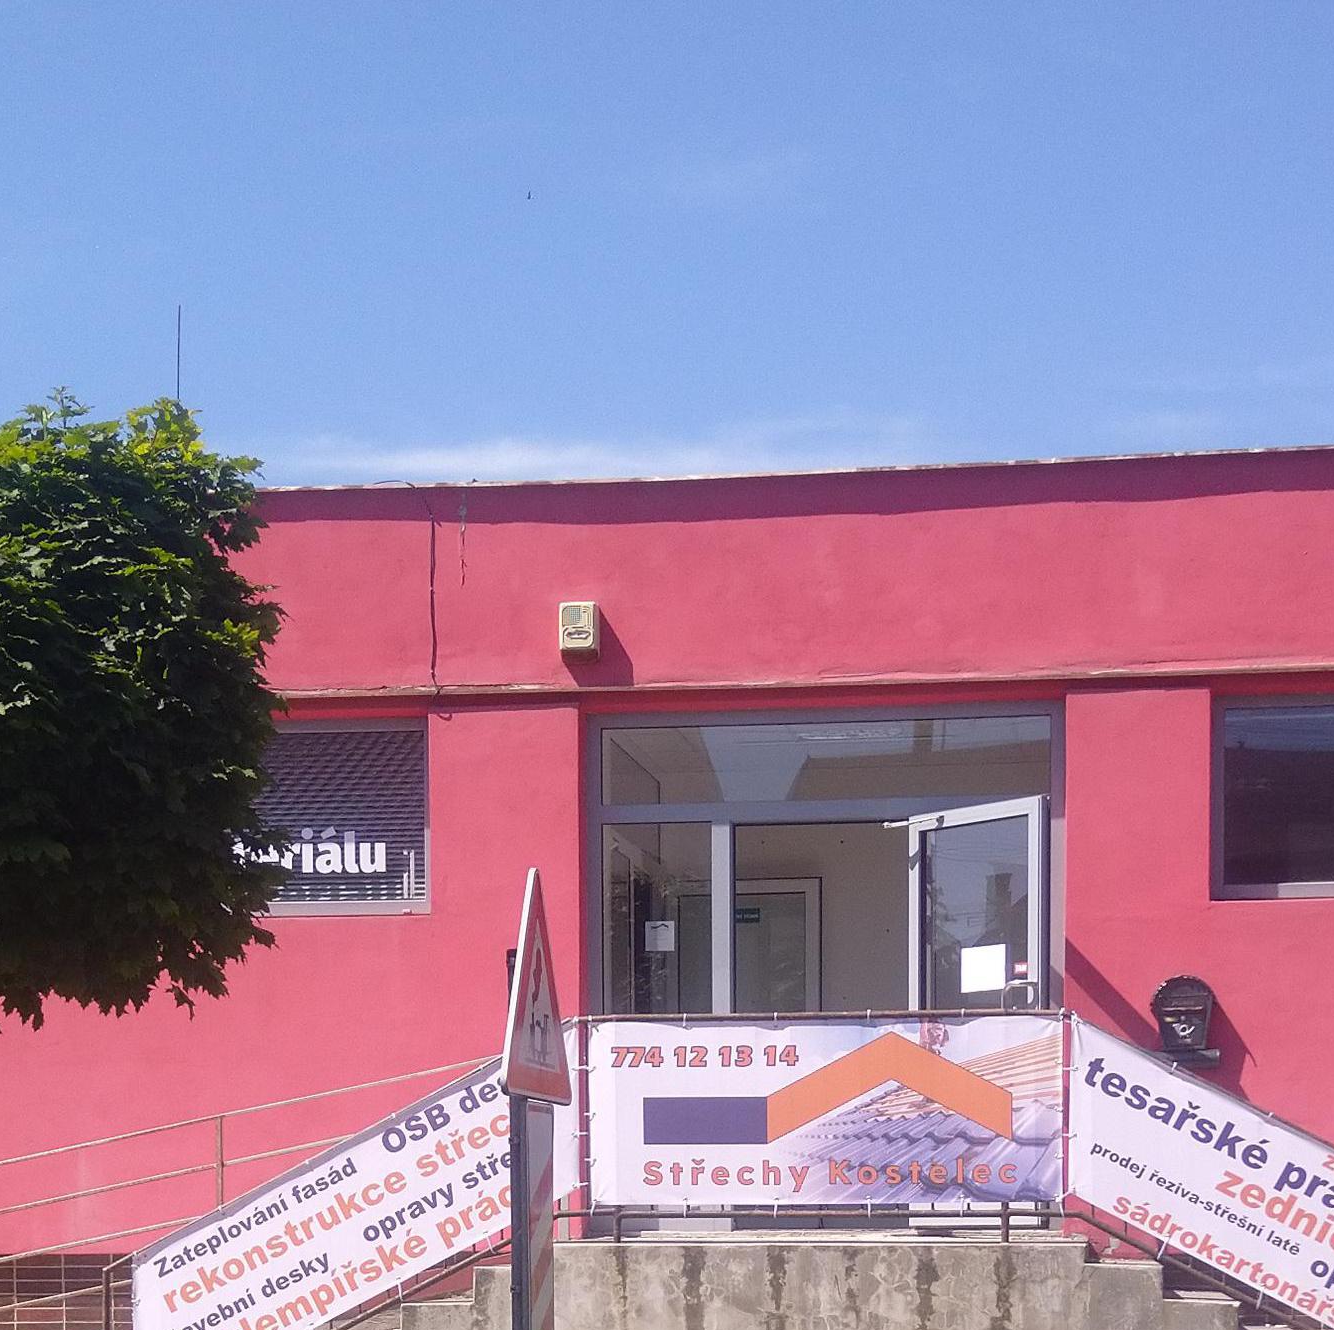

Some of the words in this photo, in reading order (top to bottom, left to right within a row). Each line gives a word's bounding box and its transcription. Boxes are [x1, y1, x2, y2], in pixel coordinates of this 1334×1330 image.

[611, 1046, 664, 1067] 774
[674, 1046, 708, 1067] 12
[718, 1045, 753, 1067] 13
[764, 1045, 799, 1066] 14
[382, 1103, 451, 1153] OSB
[1084, 1057, 1270, 1170] tesařské
[643, 1158, 810, 1192] Střechy
[828, 1157, 1018, 1186] Kostelec
[1090, 1143, 1147, 1180] prodej
[1266, 1230, 1301, 1256] latě
[153, 1193, 289, 1279] Zateplování
[292, 1157, 358, 1204] fasád
[162, 1171, 408, 1313] rekonstrukce
[416, 1112, 511, 1177] střec
[363, 1183, 452, 1242] opravy
[261, 1252, 330, 1298] desky
